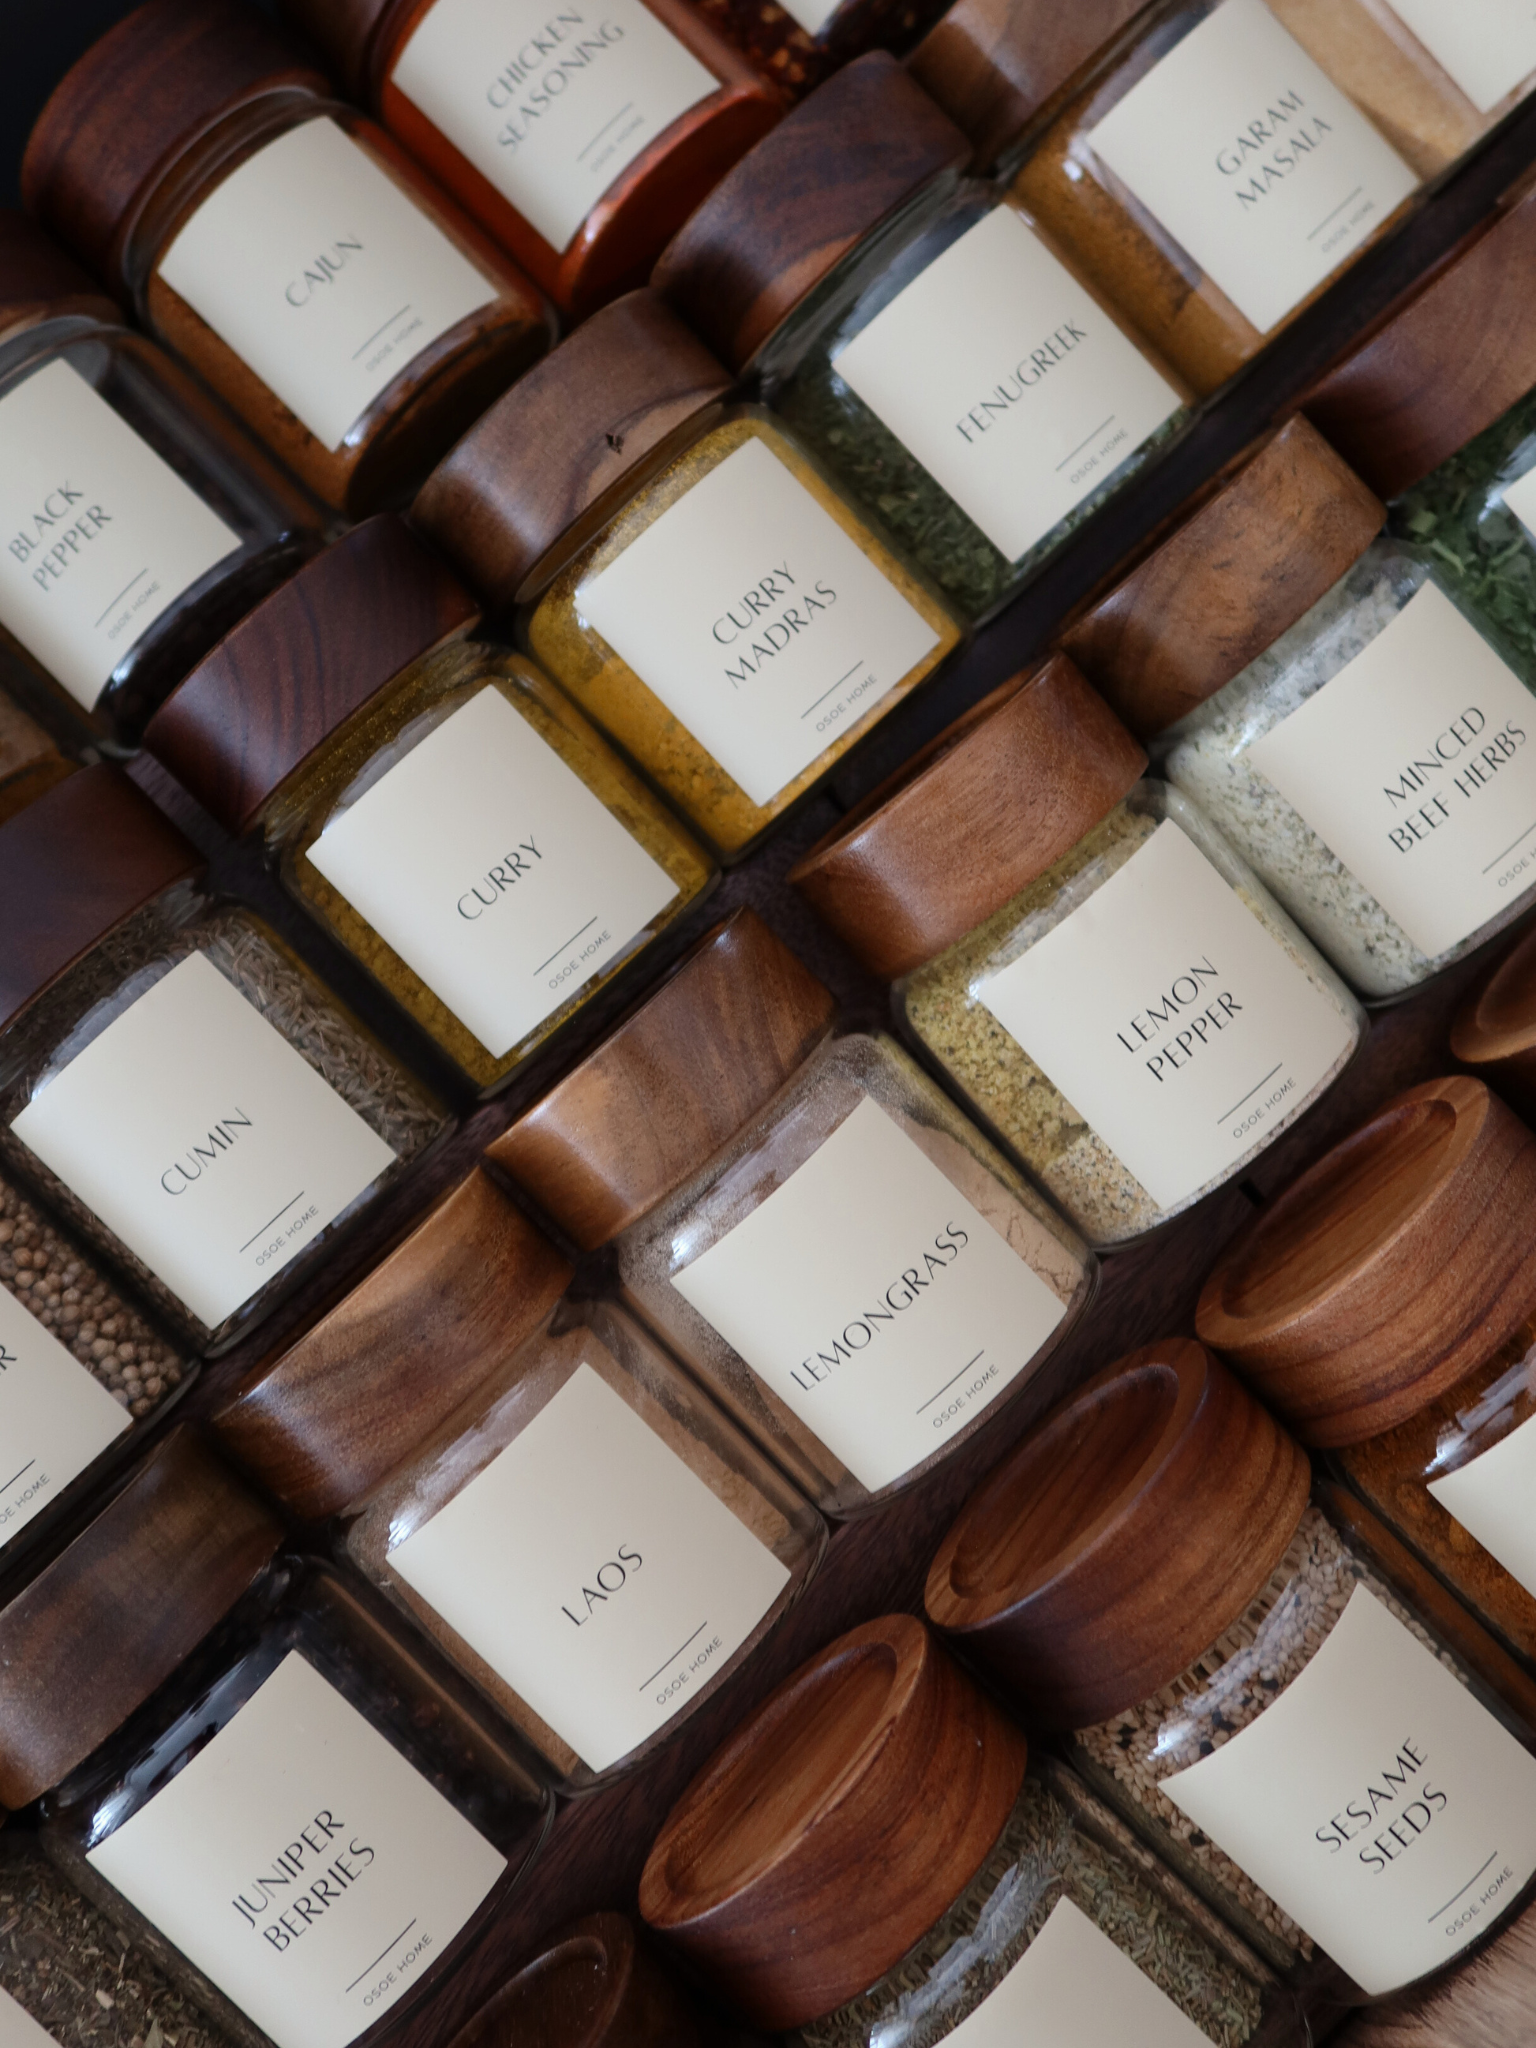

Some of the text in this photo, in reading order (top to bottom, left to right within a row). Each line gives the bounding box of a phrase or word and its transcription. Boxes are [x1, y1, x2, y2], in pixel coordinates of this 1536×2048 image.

[486, 8, 584, 110] CHICKEN
[498, 24, 625, 149] SEASONING
[1215, 90, 1304, 176] GARAM
[1235, 117, 1332, 210] MASALA
[1349, 200, 1376, 226] HOME
[285, 236, 364, 308] CAJUN
[394, 317, 424, 344] HOME
[956, 319, 1087, 443] FENUGREEK
[1070, 428, 1128, 484] OSOE HOME
[8, 480, 84, 563] BLACK
[32, 505, 112, 592] PEPPER
[108, 581, 161, 640] OSOE HOME
[713, 562, 795, 644] CURRY
[724, 581, 836, 689] MADRAS
[816, 674, 877, 732] OSOE HOME
[1383, 707, 1485, 808] MINCED
[1388, 722, 1526, 853] BEEF HERBS
[457, 835, 542, 920] CURRY
[1498, 857, 1530, 887] OSOE
[549, 930, 611, 989] OSOE HOME
[1117, 956, 1218, 1053] LEMON
[1146, 992, 1242, 1082] PEPPER
[1233, 1077, 1296, 1138] OSOE HOME
[161, 1107, 252, 1195] CUMIN
[256, 1205, 318, 1266] OSOE HOME
[790, 1222, 968, 1391] LEMONGRASS
[933, 1364, 999, 1428] OSOE HOME
[15, 1473, 50, 1508] HOME
[561, 1544, 642, 1626] LAOS
[656, 1636, 722, 1705] OSOE HOME
[1316, 1737, 1427, 1853] SESAME
[1359, 1782, 1447, 1873] SEEDS
[232, 1810, 344, 1929] JUNIPER
[263, 1838, 374, 1952] BERRIES
[1445, 1866, 1513, 1936] OSOE HOME
[363, 1933, 432, 2006] OSOE HOME
